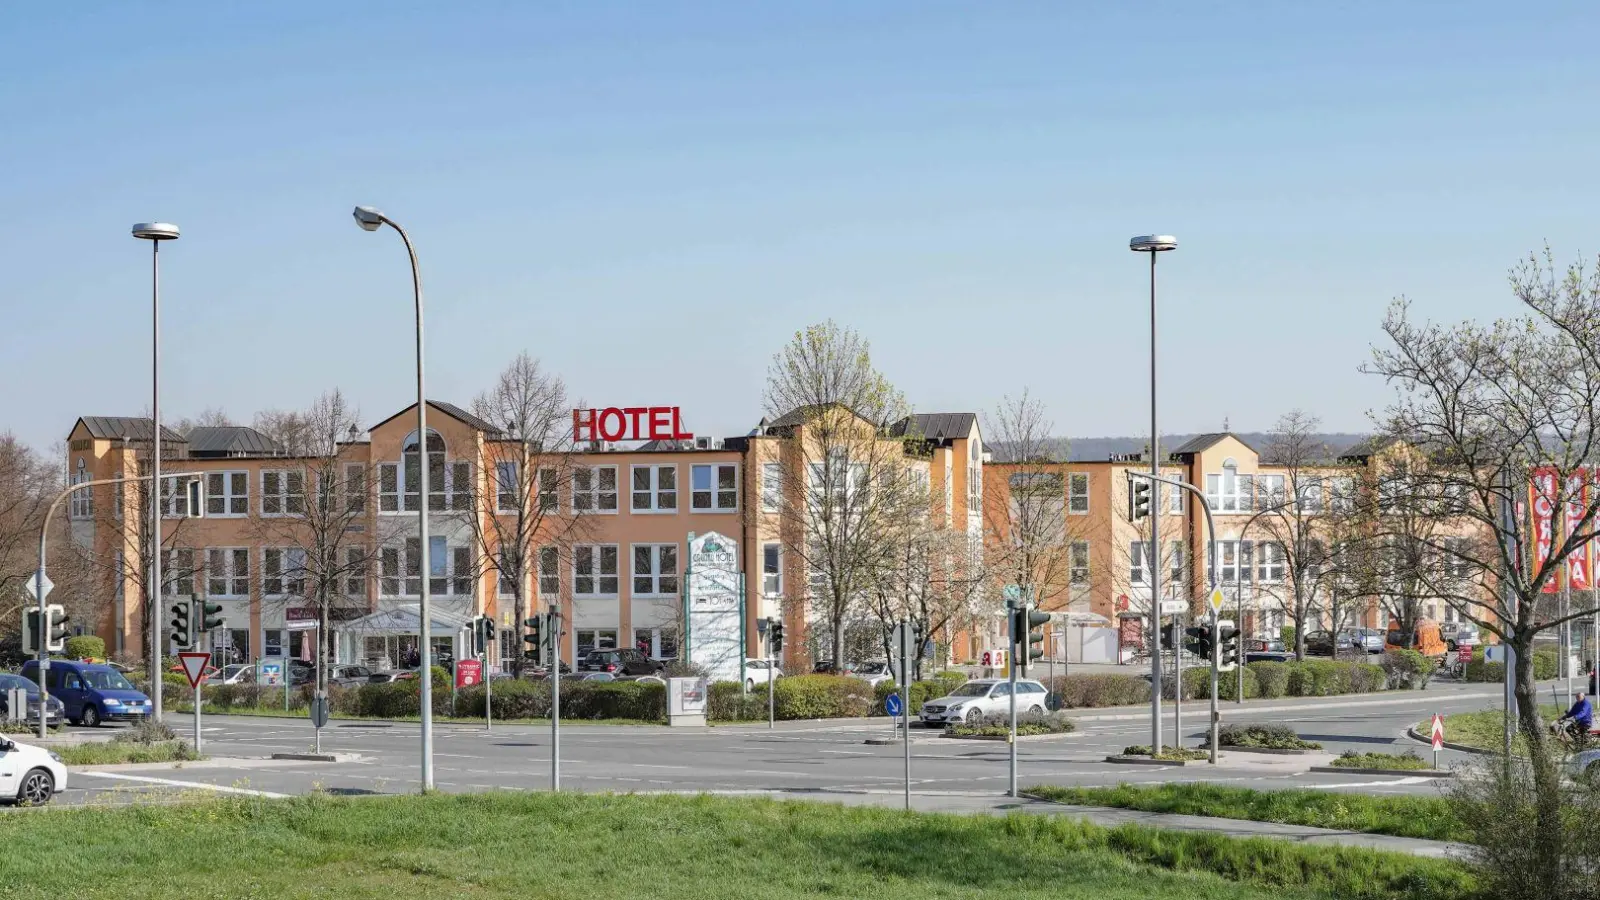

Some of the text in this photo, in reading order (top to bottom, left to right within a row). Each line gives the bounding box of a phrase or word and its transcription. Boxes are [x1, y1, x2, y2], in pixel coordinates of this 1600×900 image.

[573, 406, 694, 442] HOTEL
[1534, 474, 1557, 584] NORM
[715, 552, 735, 562] HOTEL
